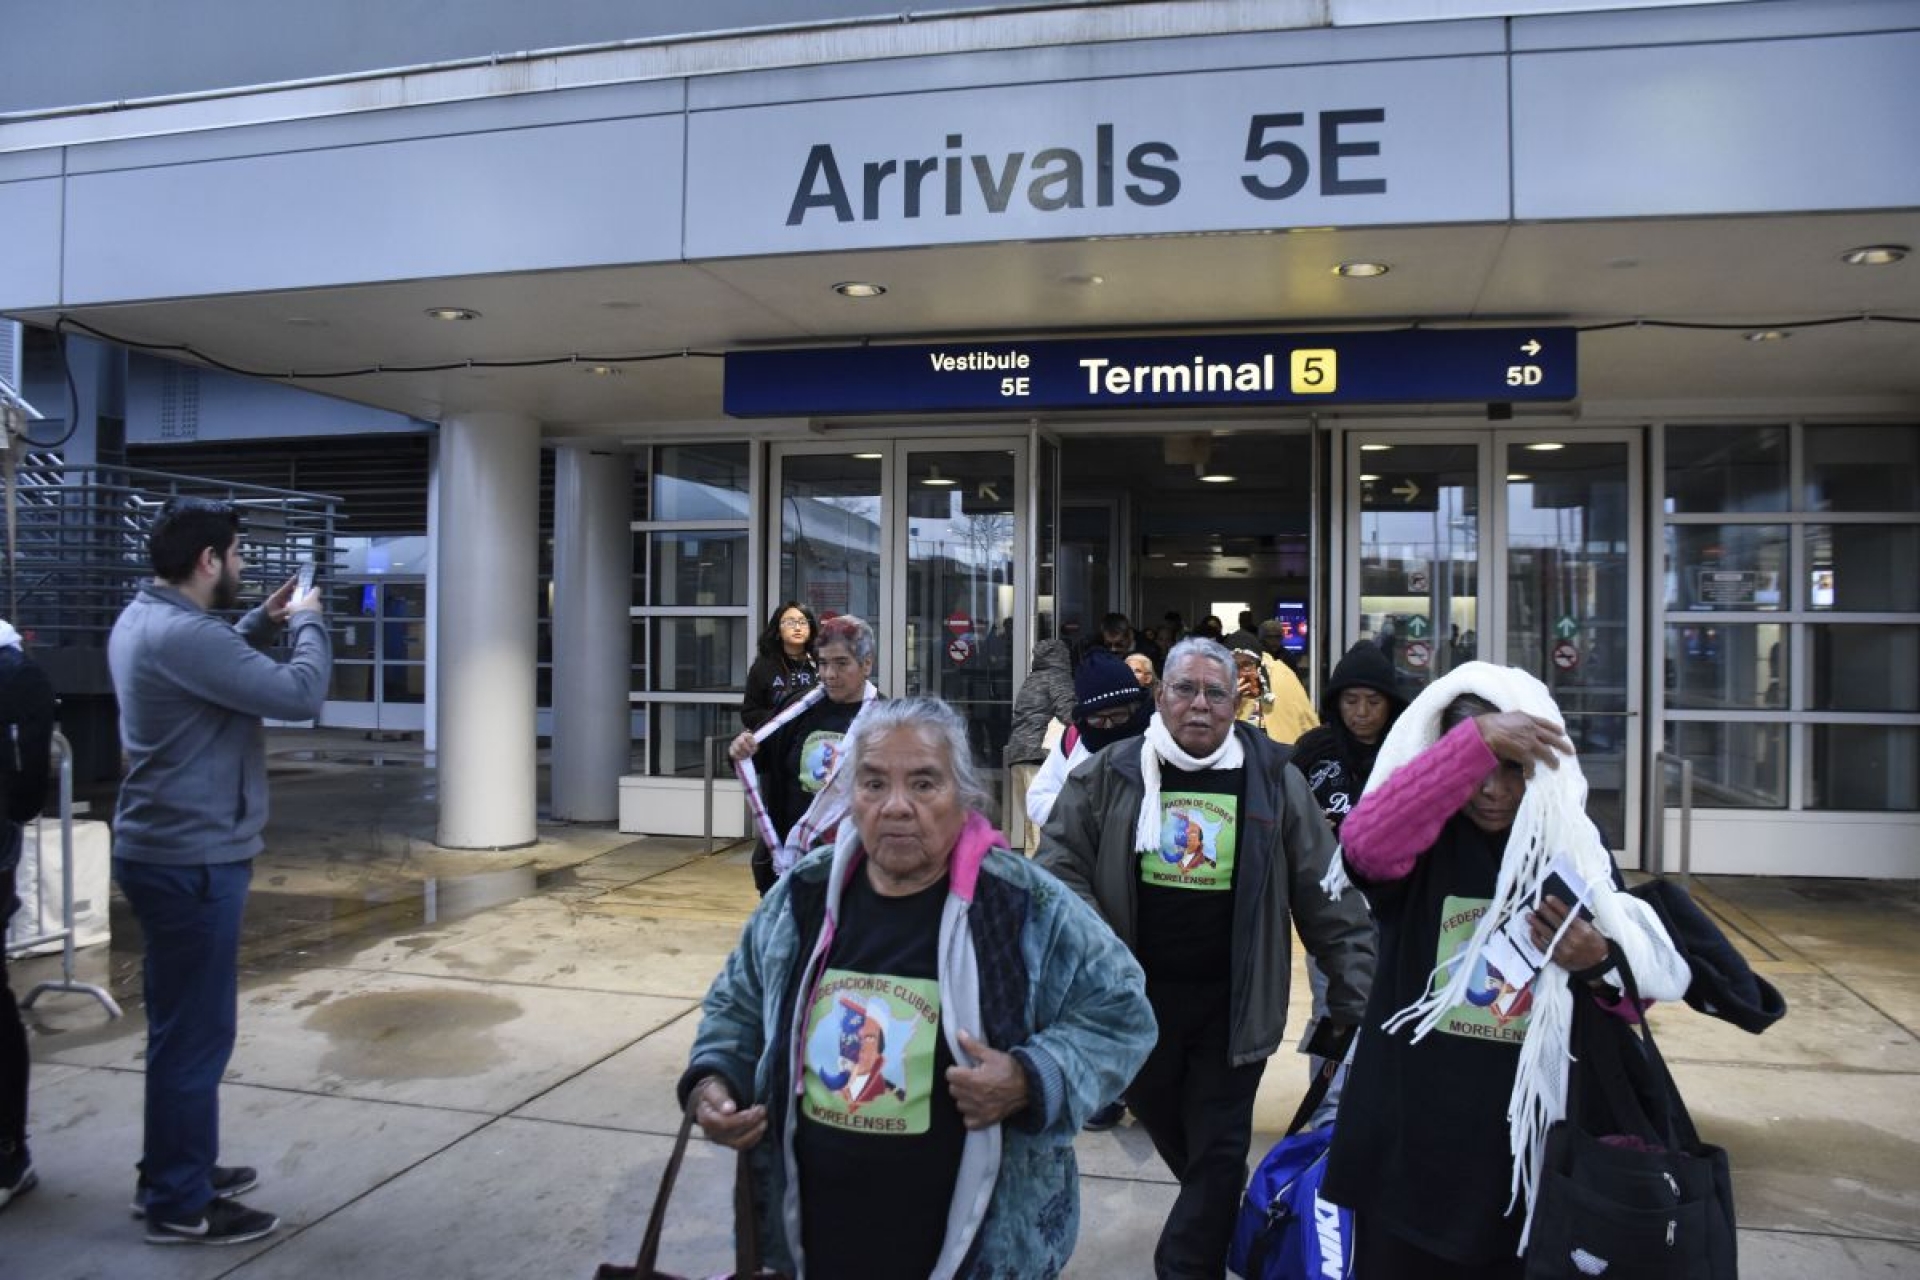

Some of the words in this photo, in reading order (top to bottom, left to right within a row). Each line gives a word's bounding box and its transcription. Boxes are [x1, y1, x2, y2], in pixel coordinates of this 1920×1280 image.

[785, 123, 1181, 226] Arrivals
[1241, 107, 1387, 200] 5E
[930, 350, 1030, 372] Vestibule
[1079, 354, 1274, 394] Terminal
[1302, 357, 1325, 386] 5
[1506, 365, 1542, 386] 5D
[1000, 376, 1030, 397] 5E
[1193, 799, 1204, 809] DE
[1153, 871, 1217, 886] MORELENSES
[1442, 905, 1488, 934] FEDERA
[875, 977, 892, 994] DE
[893, 984, 938, 1025] CLUBES
[1450, 1020, 1528, 1041] MORELEN
[812, 1103, 907, 1132] MORELENSES
